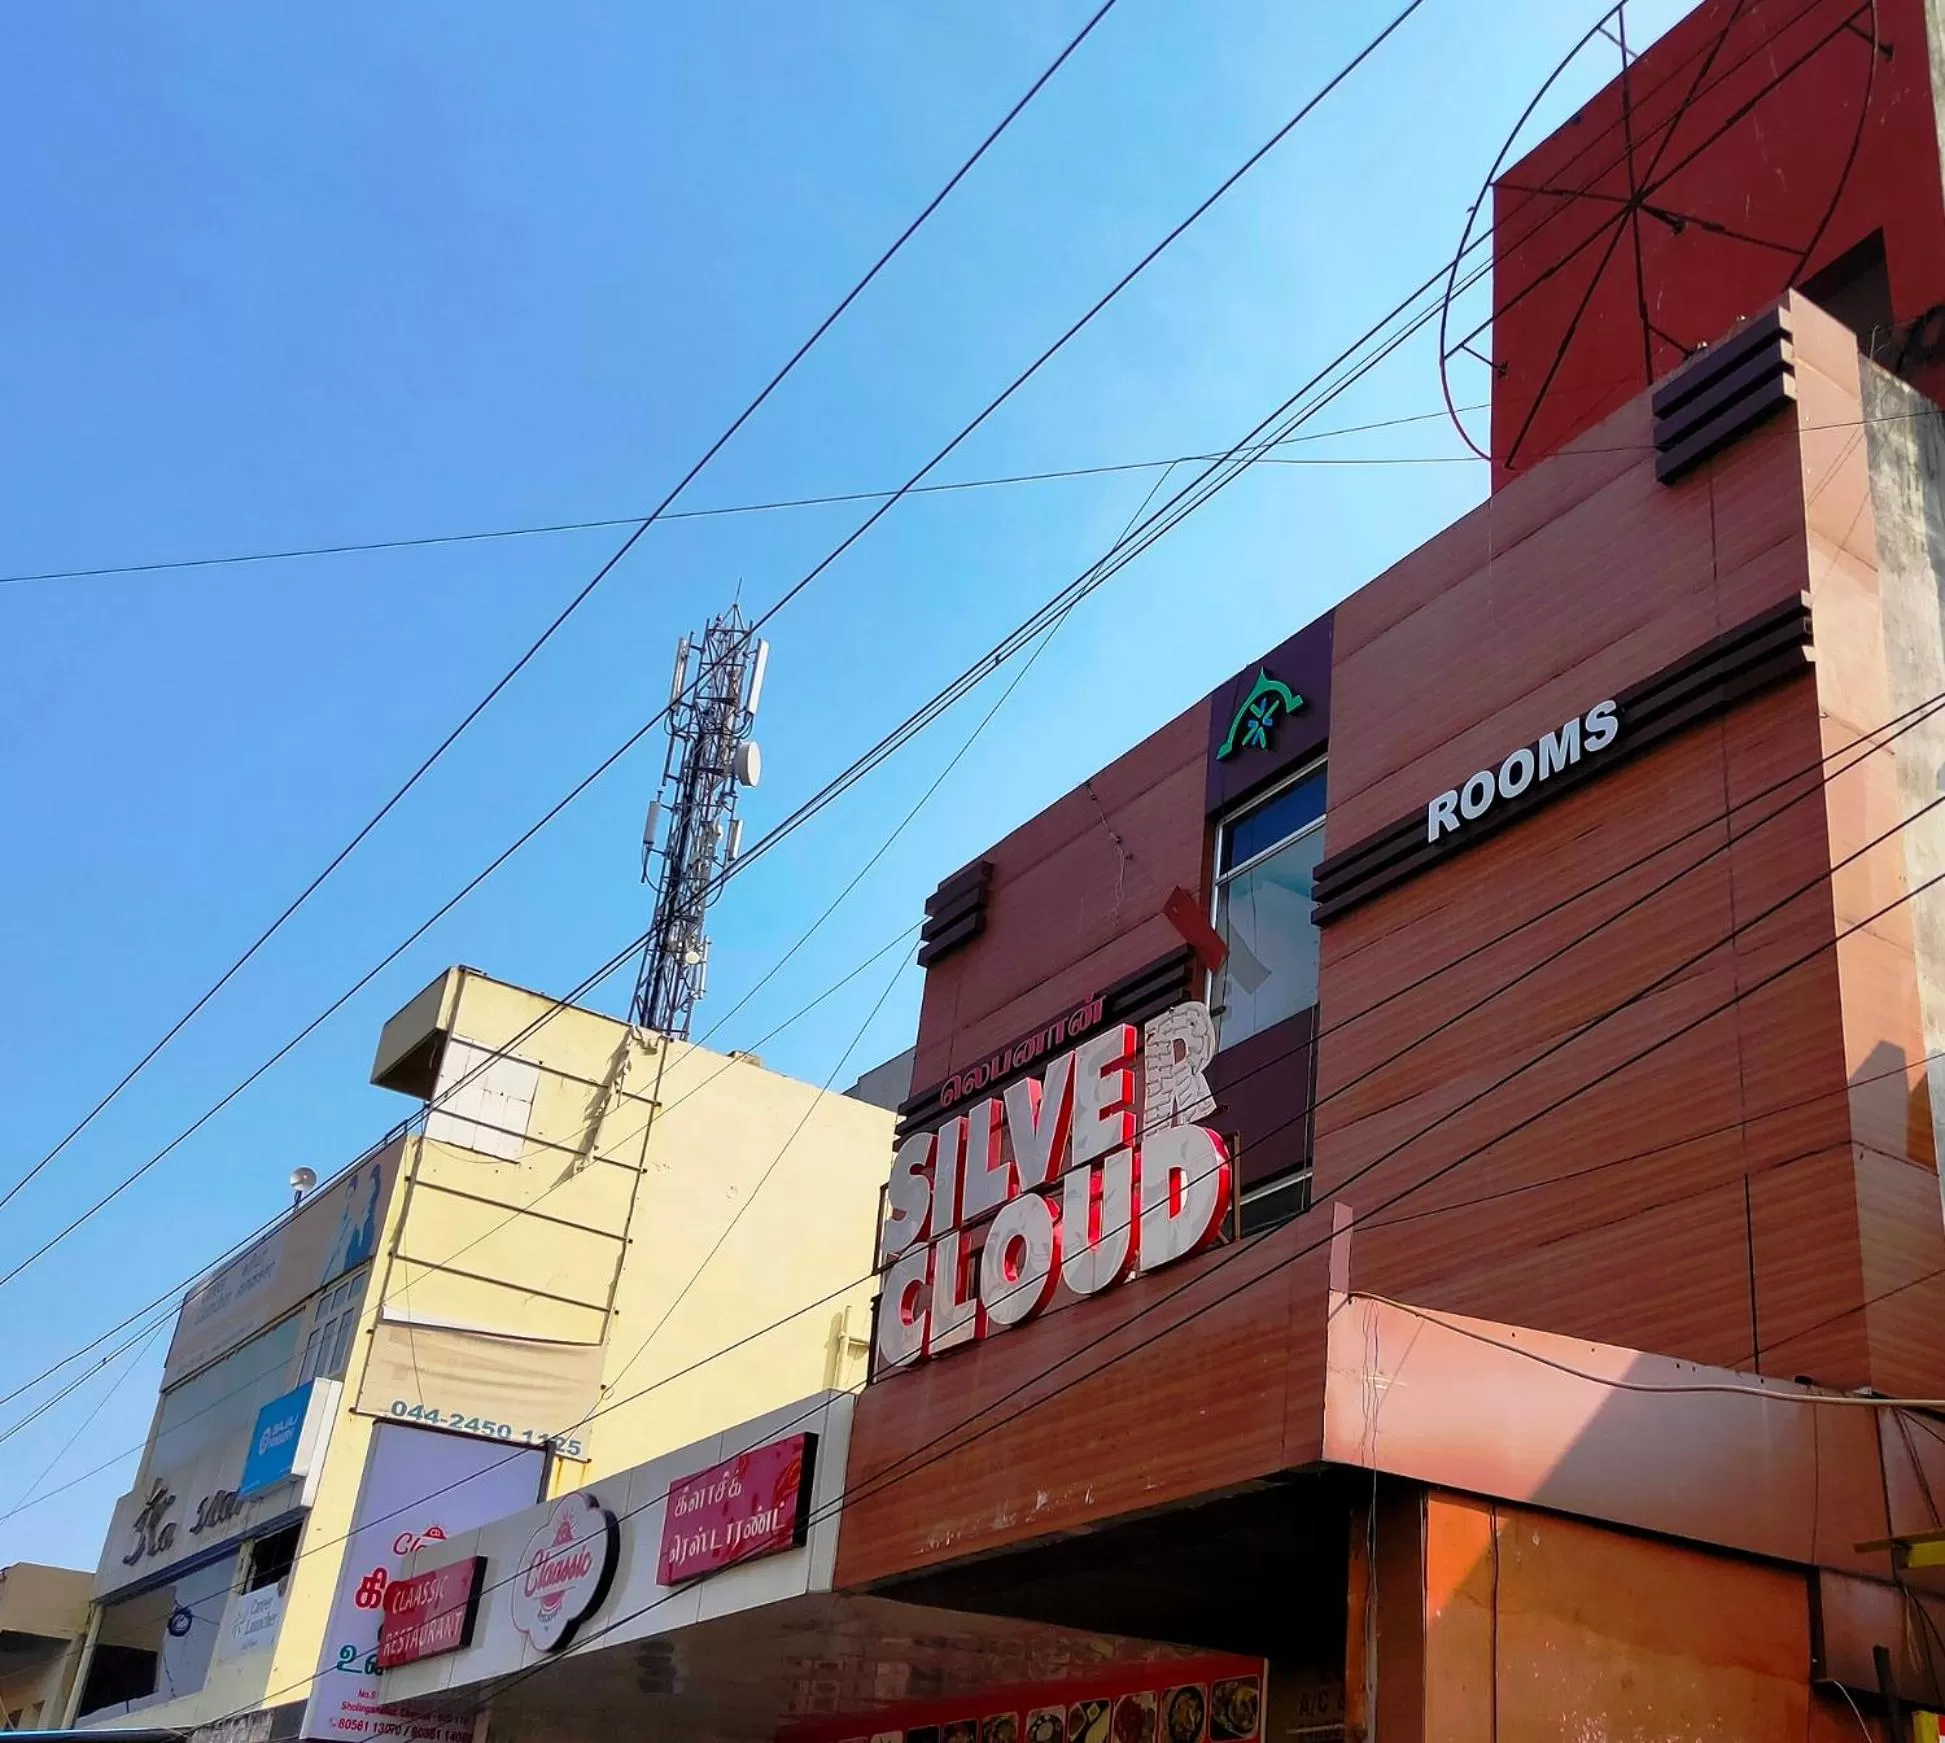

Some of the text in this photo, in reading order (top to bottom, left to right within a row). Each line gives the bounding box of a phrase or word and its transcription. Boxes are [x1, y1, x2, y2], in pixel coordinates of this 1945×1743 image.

[1428, 699, 1619, 844] ROOMS
[940, 993, 1107, 1107] லெபனான்
[883, 1001, 1217, 1258] SILVER
[879, 1124, 1230, 1366] CLOUD
[391, 1400, 511, 1440] 044-2450
[382, 1611, 464, 1657] RESTAURANT
